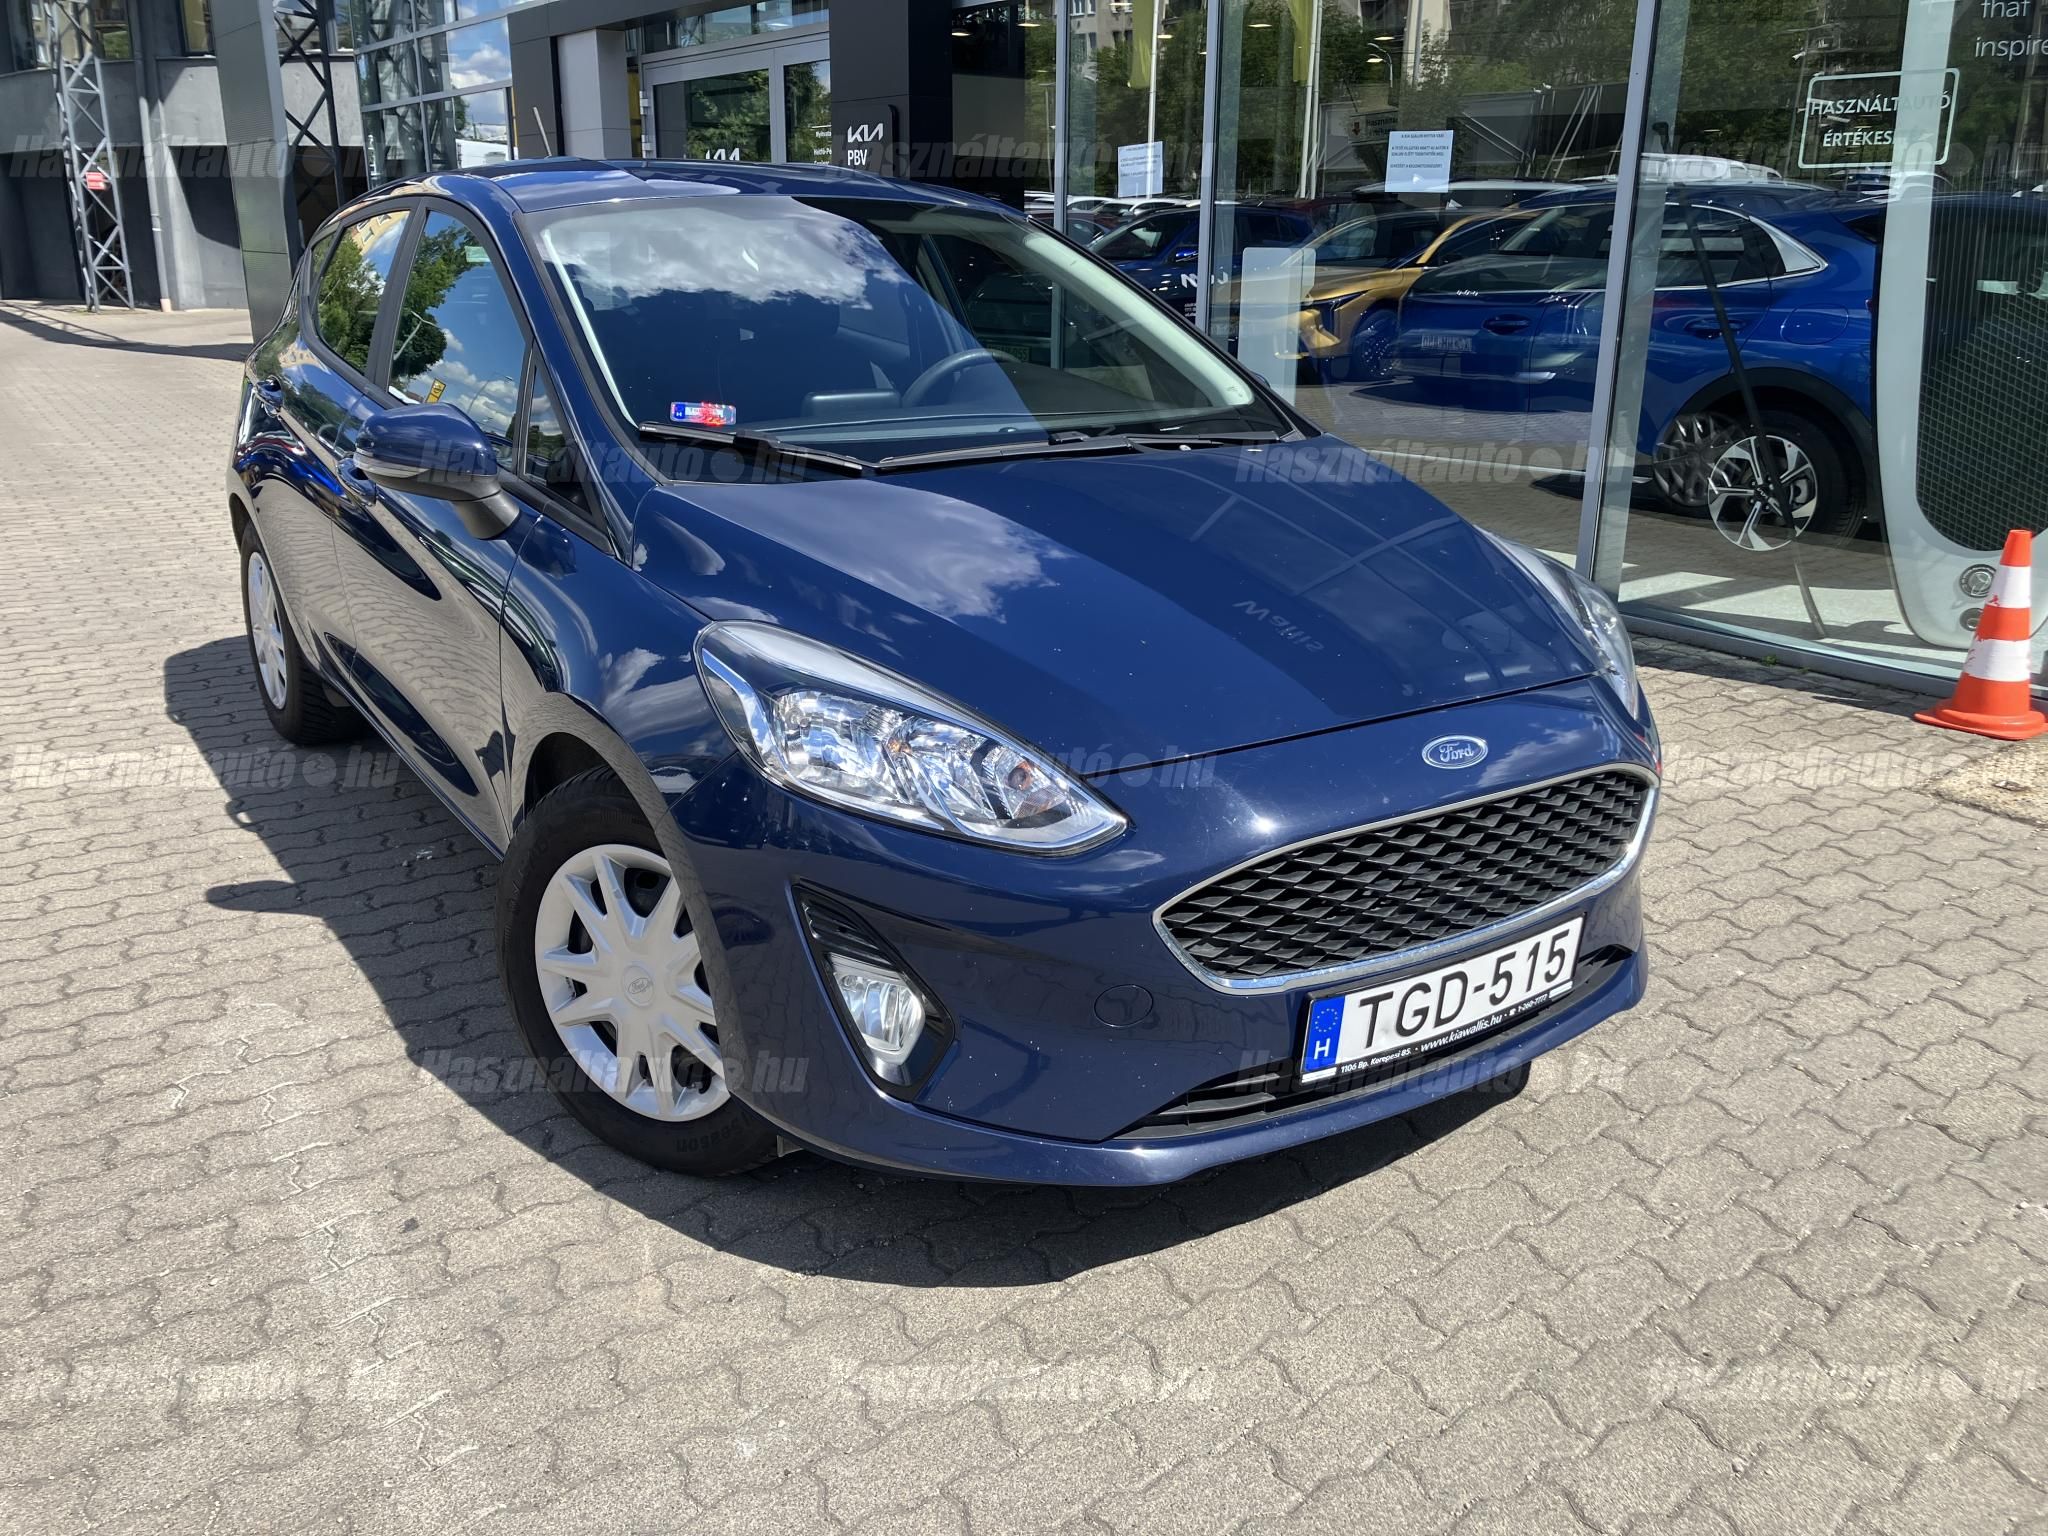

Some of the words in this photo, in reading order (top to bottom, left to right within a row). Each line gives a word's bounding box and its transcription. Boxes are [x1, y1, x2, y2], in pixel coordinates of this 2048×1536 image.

[1980, 0, 2031, 18] that
[847, 123, 884, 143] KIA
[847, 149, 867, 166] PBV
[1439, 742, 1475, 762] Ford
[1358, 928, 1570, 1049] TGD-515
[1421, 1014, 1502, 1052] www.kiawallis.hu
[1313, 1038, 1330, 1059] H
